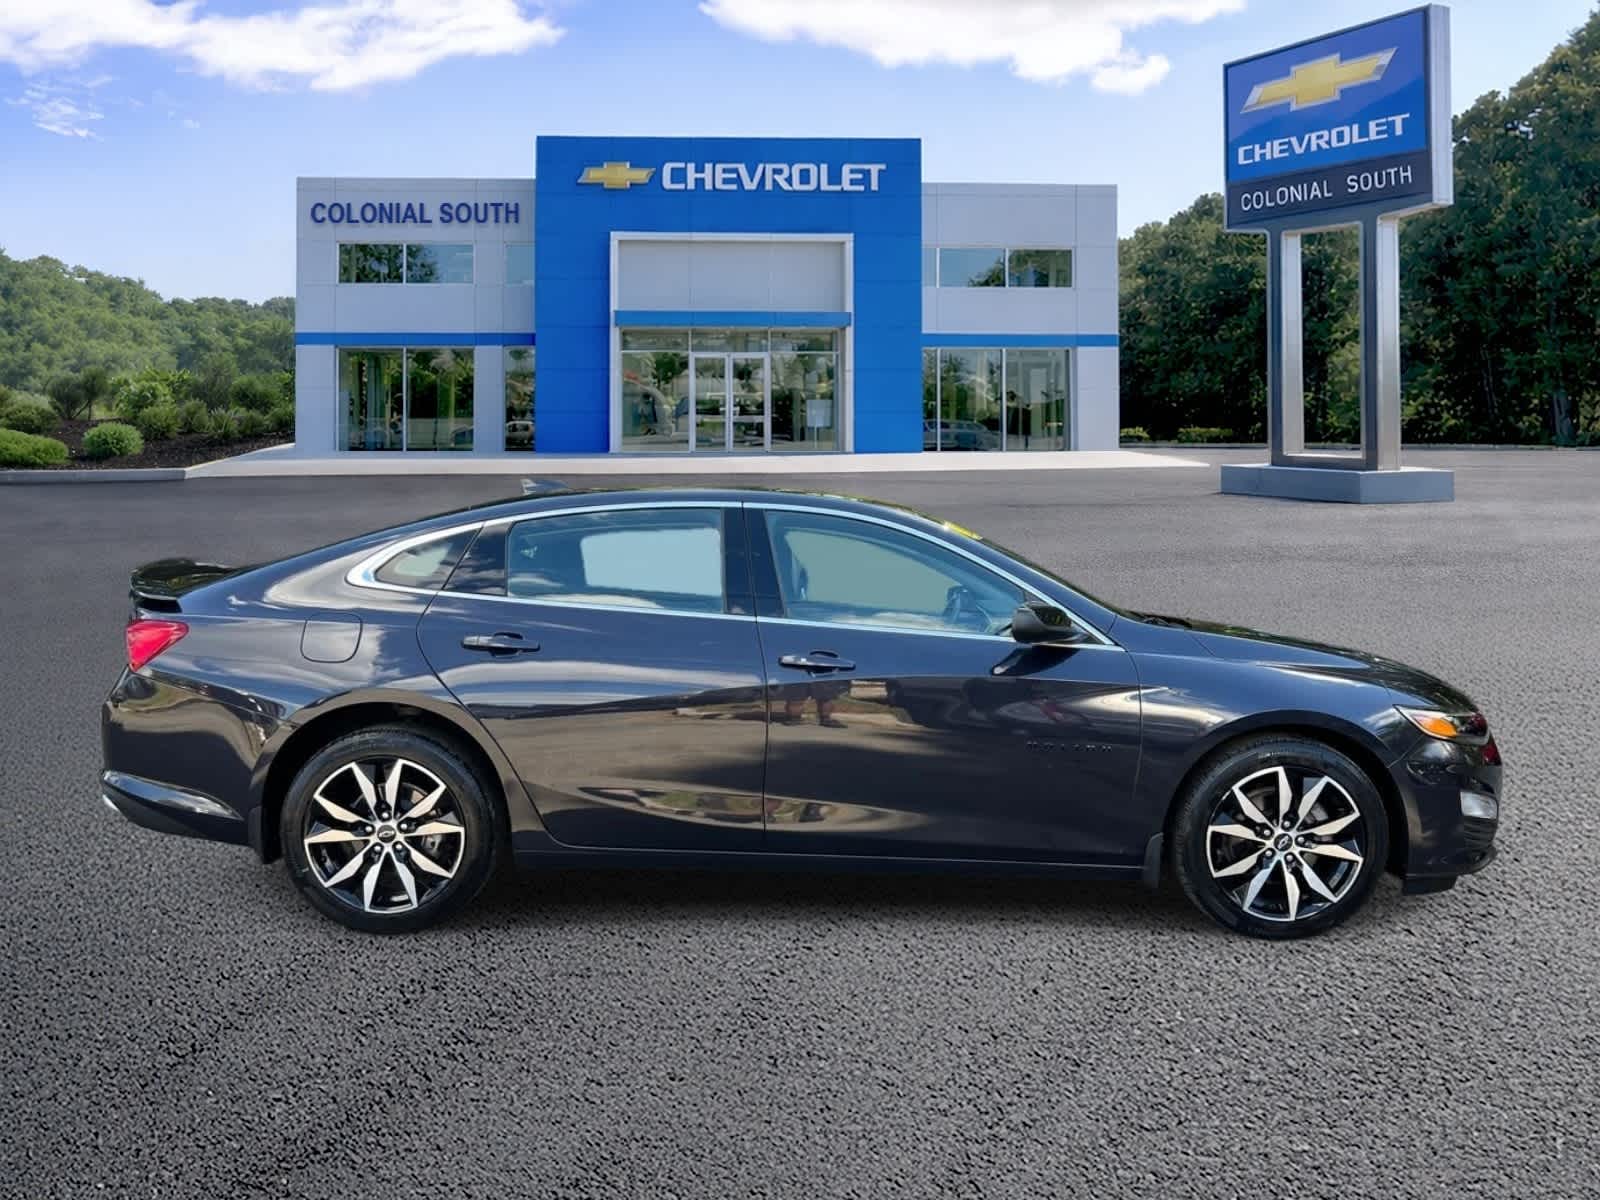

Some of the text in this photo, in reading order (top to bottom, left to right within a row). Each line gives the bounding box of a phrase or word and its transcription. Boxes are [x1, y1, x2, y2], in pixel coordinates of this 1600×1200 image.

[1238, 113, 1410, 164] CHEVROLET
[662, 162, 886, 191] CHEVROLET
[1241, 165, 1412, 211] COLONIAL SOUTH
[311, 202, 520, 224] COLONIAL SOUTH
